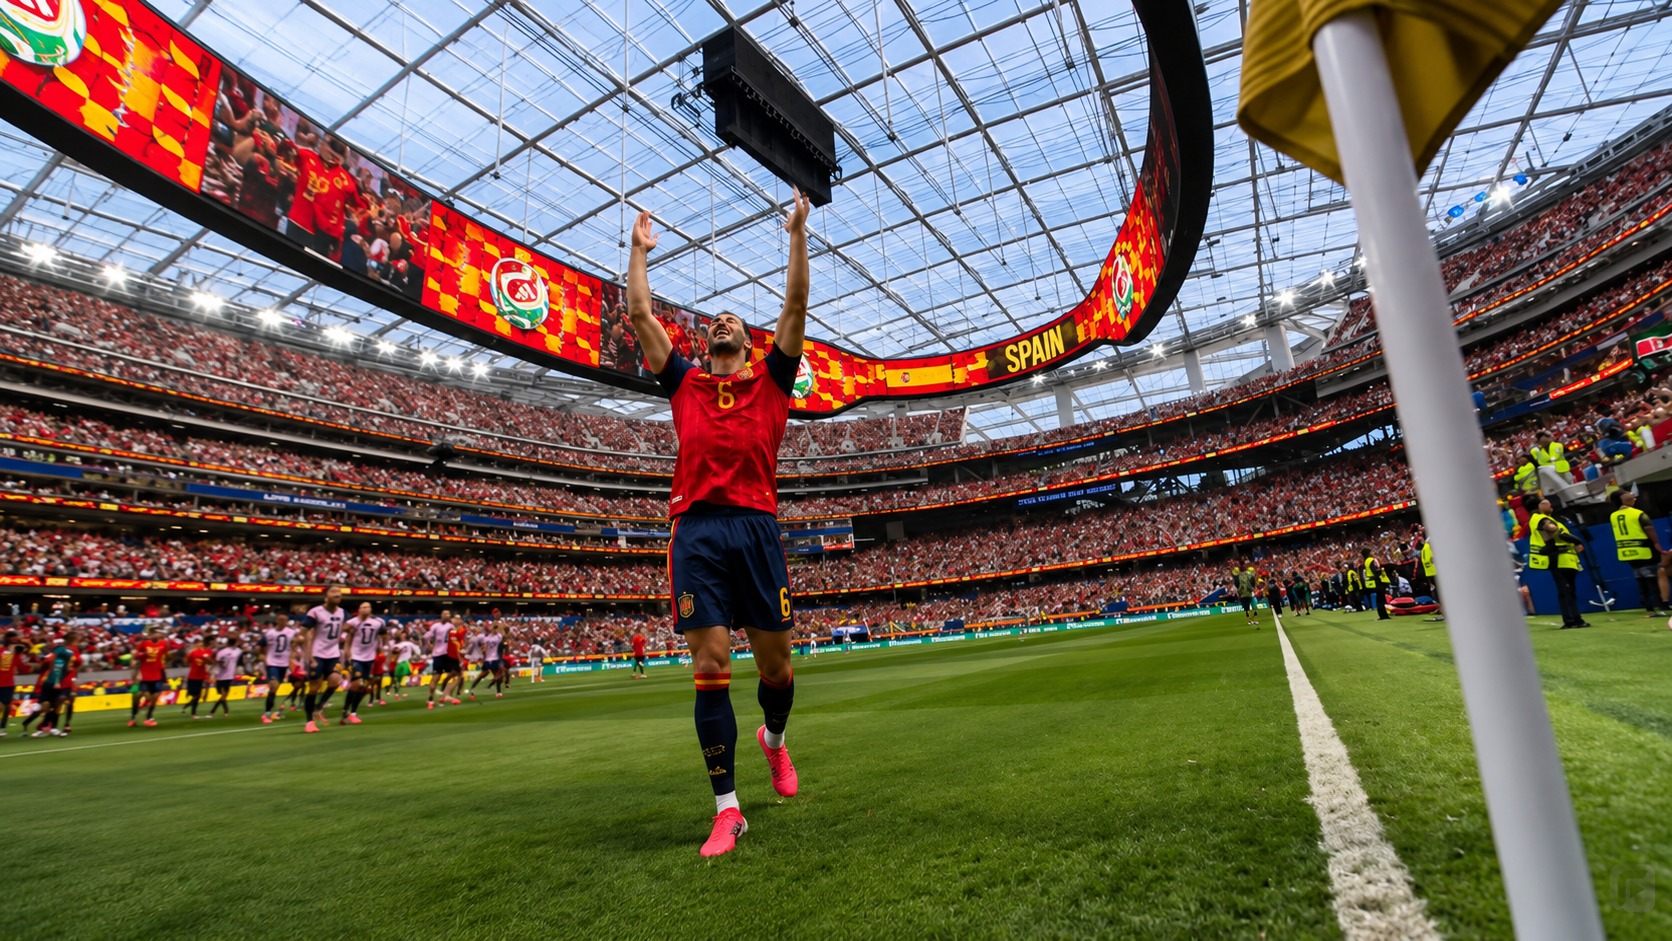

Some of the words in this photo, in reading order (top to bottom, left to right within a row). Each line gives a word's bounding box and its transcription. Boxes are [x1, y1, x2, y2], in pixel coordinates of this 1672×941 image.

[1005, 324, 1065, 373] SPAIN
[717, 380, 735, 409] 6
[779, 586, 791, 617] 6
